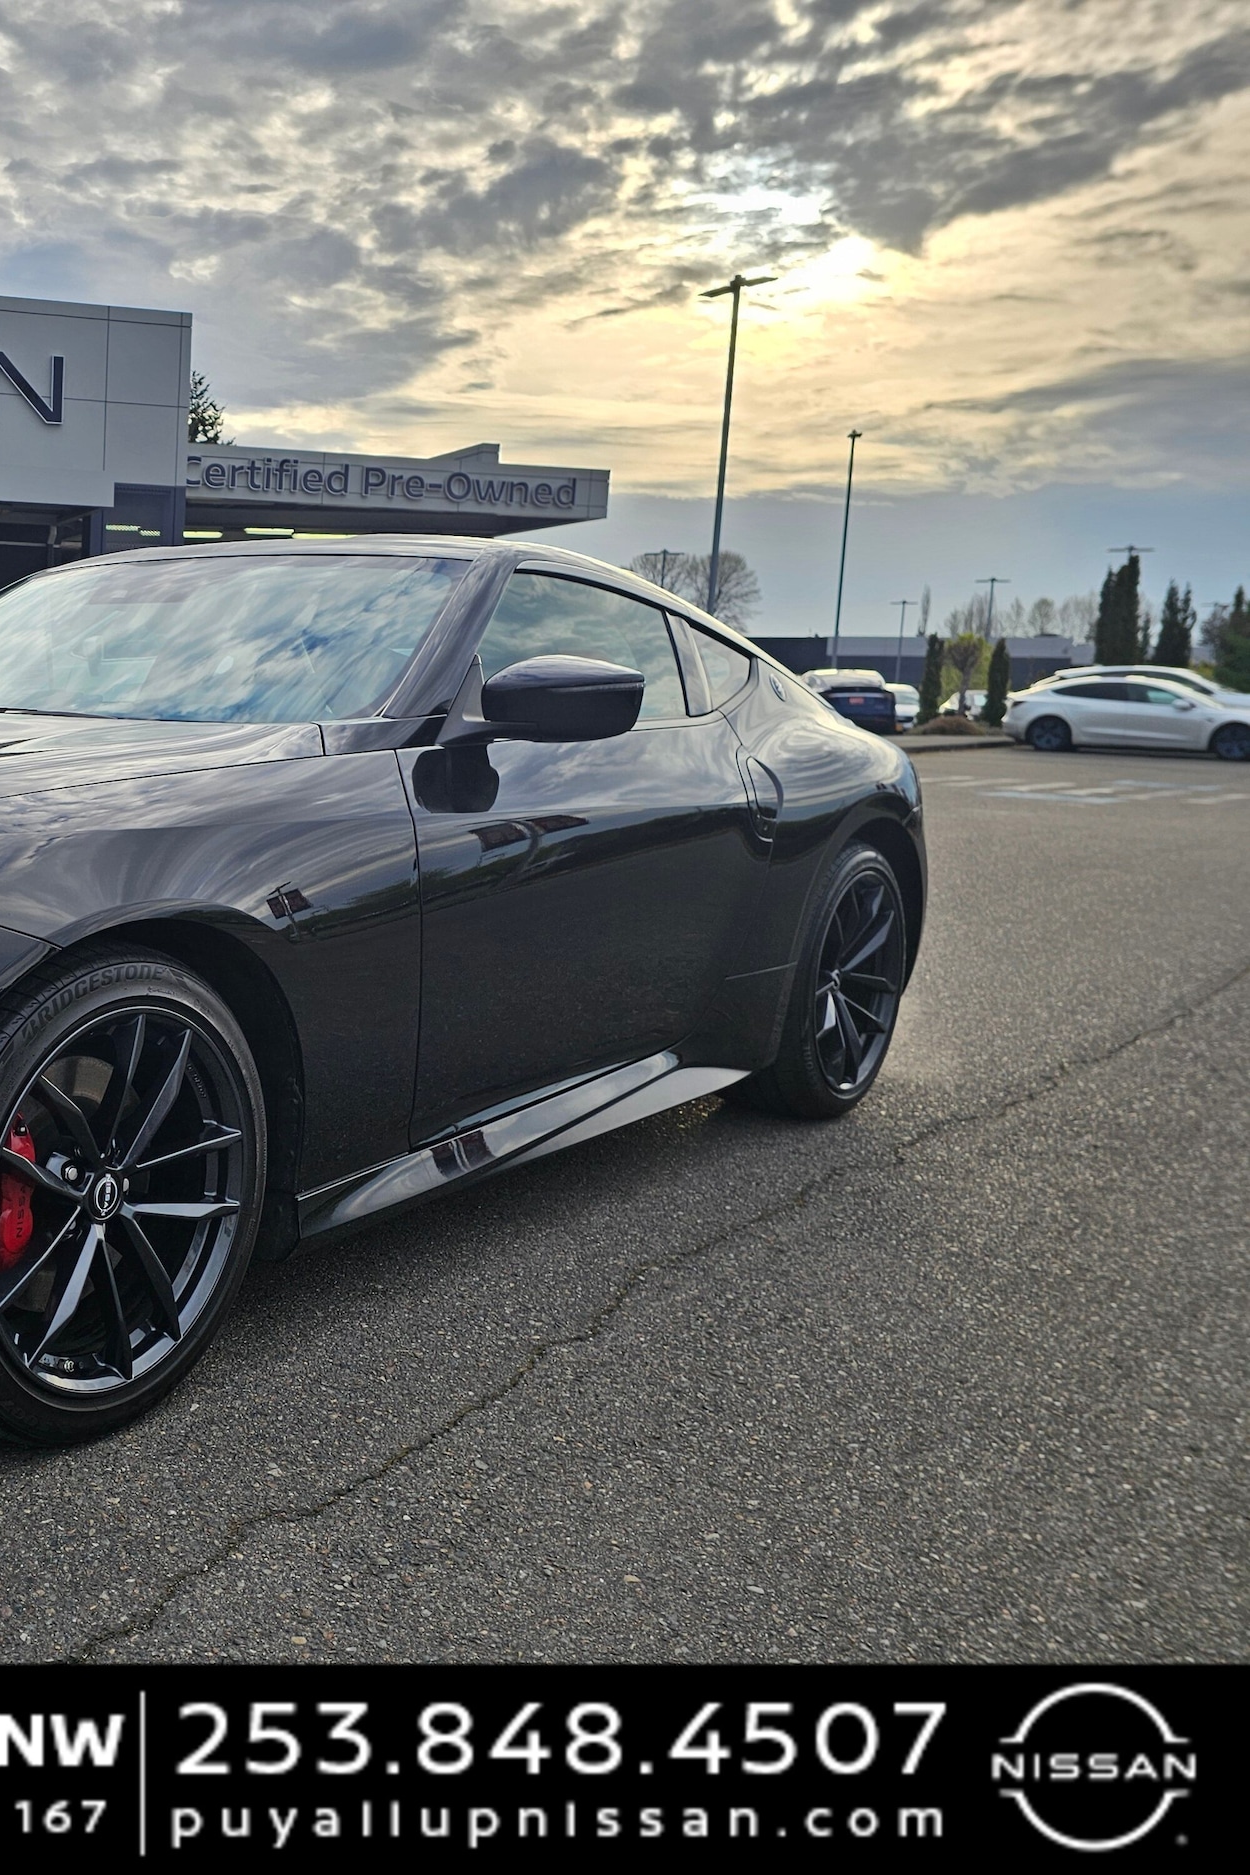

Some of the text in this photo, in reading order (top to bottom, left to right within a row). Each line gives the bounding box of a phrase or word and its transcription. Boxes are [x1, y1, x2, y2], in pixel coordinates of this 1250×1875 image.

[186, 456, 578, 508] Certified Pre-Owned
[21, 964, 166, 1041] BRIDGESTONE
[15, 1185, 26, 1239] NISSA
[100, 1173, 113, 1217] NISSAN
